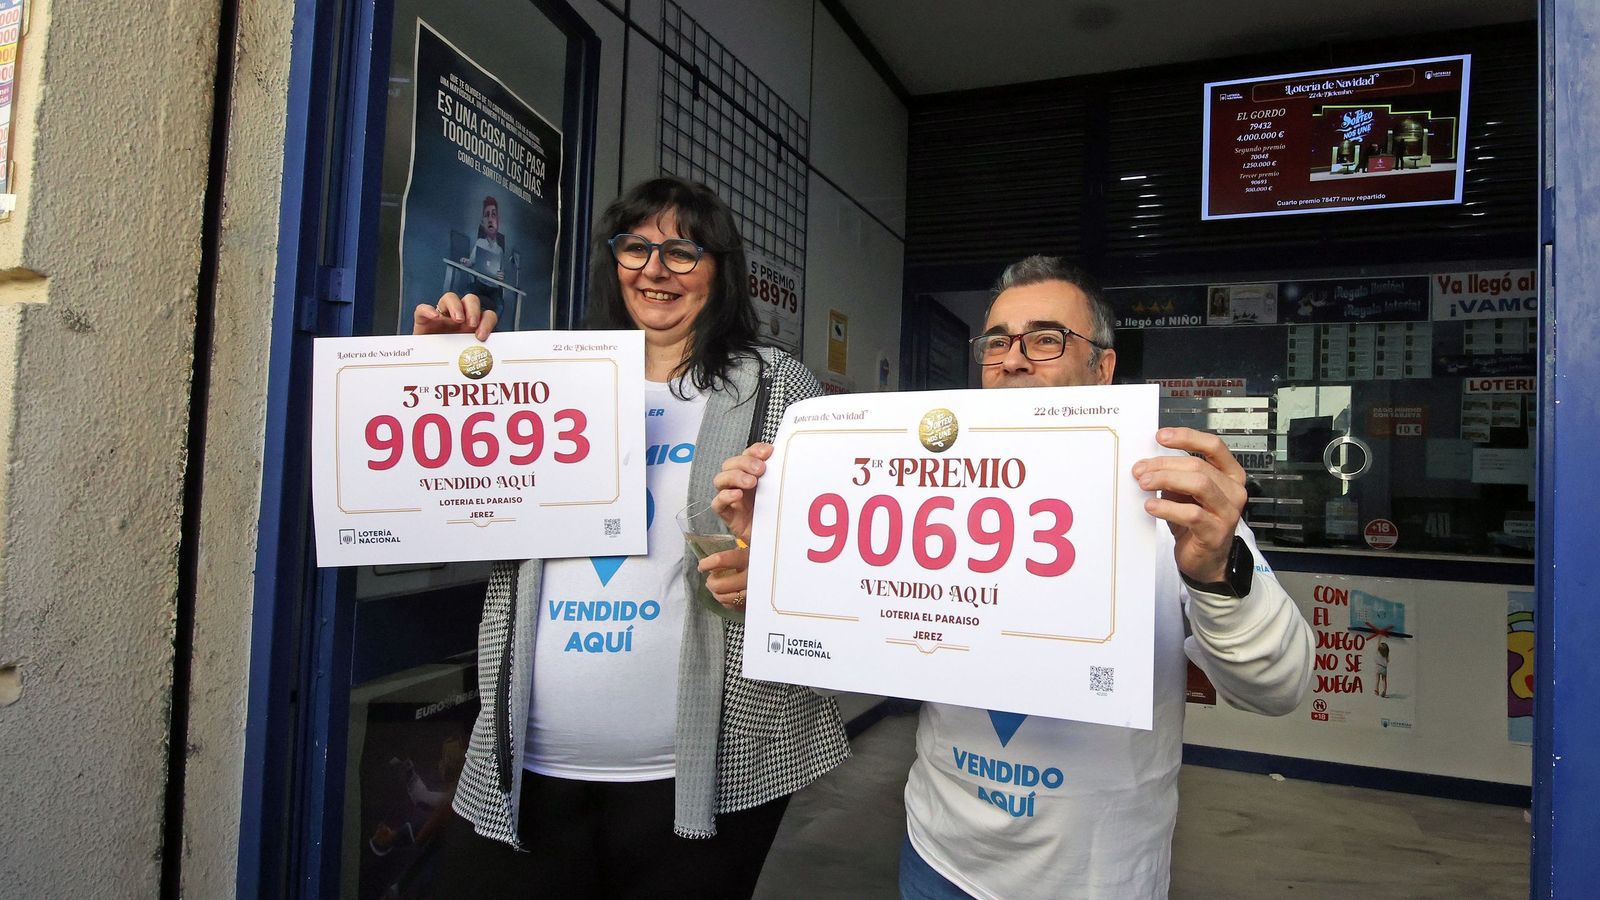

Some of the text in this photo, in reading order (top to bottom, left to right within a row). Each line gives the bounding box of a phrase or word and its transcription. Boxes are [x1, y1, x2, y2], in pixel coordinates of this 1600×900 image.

[1322, 80, 1334, 90] de
[1336, 73, 1379, 88] Navidad
[1236, 108, 1286, 121] EL GORDO
[1249, 121, 1272, 131] 79432
[1357, 123, 1372, 136] UNE
[438, 89, 452, 117] ES
[455, 101, 478, 134] UNA
[480, 119, 507, 151] COSA
[508, 137, 526, 165] QUE
[526, 151, 546, 180] PASA
[1236, 130, 1285, 142] 4.000.000 €
[442, 115, 505, 172] TOOOOODOS
[506, 157, 521, 184] LOS
[1234, 143, 1286, 155] Segundo premio
[457, 149, 474, 168] COMO
[474, 160, 482, 173] EL
[482, 164, 502, 185] SORTEO
[1258, 171, 1280, 180] premio
[1356, 193, 1386, 202] repartido
[760, 265, 796, 291] PREMIO
[1438, 271, 1536, 296] Ya llegó al
[748, 274, 798, 314] 88979
[1125, 316, 1151, 329] llegó
[1155, 316, 1165, 326] el
[1168, 314, 1202, 325] NIÑO!
[379, 347, 414, 358] Navidad
[574, 344, 619, 353] Diciembre
[1196, 379, 1243, 388] VIAJERA
[1470, 379, 1537, 391] LOTERI
[435, 381, 550, 408] PREMIO
[1171, 389, 1190, 397] DEL
[645, 409, 665, 418] ER
[820, 413, 831, 421] de
[832, 409, 869, 421] Navidad
[1034, 405, 1121, 418] 22 de Diciembre
[364, 408, 591, 471] 90693
[889, 457, 1027, 489] PREMIO
[419, 471, 536, 491] VENDIDO AQUÍ
[440, 499, 475, 507] LOTERIA
[486, 496, 523, 505] PARAISO
[469, 511, 494, 519] JEREZ
[358, 529, 392, 538] LOTERÍA
[806, 492, 1076, 577] 90693
[1371, 522, 1391, 534] +18
[358, 536, 401, 544] NACIONAL
[860, 578, 999, 608] VENDIDO AQUÍ
[1313, 585, 1348, 607] CON
[549, 599, 661, 622] VENDIDO
[880, 609, 980, 627] LOTERIA EL PARAISO
[1313, 607, 1332, 627] EL
[564, 624, 634, 653] AQUÍ
[912, 630, 943, 642] JEREZ
[1315, 630, 1366, 651] JUEGO
[787, 637, 823, 651] LOTERÍA
[787, 648, 832, 660] NACIONAL
[1313, 653, 1362, 673] NO SE
[1312, 675, 1363, 694] JUEGA
[952, 746, 1064, 790] VENDIDO
[977, 786, 1037, 818] AQUÍ
